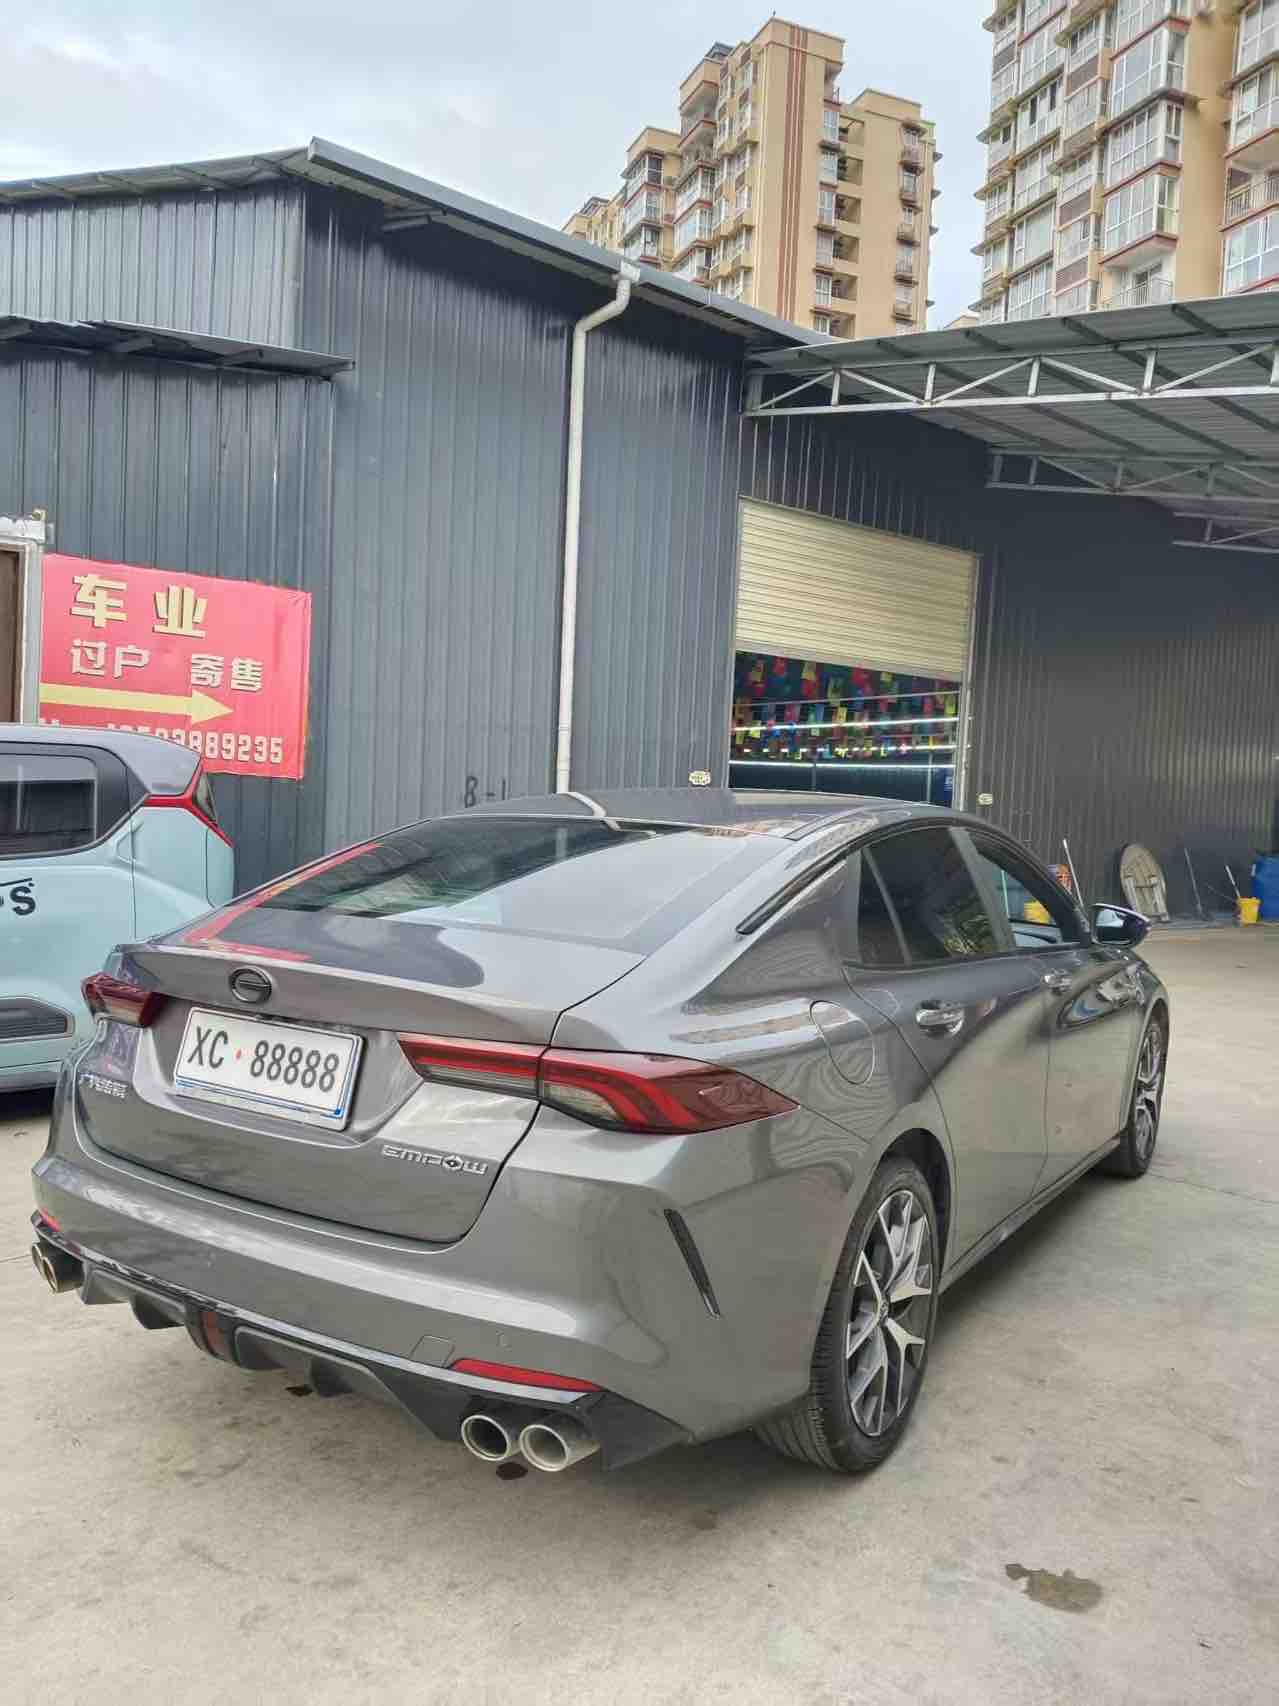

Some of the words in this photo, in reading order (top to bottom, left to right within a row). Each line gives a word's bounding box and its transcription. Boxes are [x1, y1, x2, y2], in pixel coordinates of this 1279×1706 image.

[70, 573, 208, 638] 车业
[71, 638, 149, 679] 过户
[190, 653, 264, 693] 寄售
[106, 723, 283, 764] 3889235
[382, 1143, 489, 1175] EMPOW
